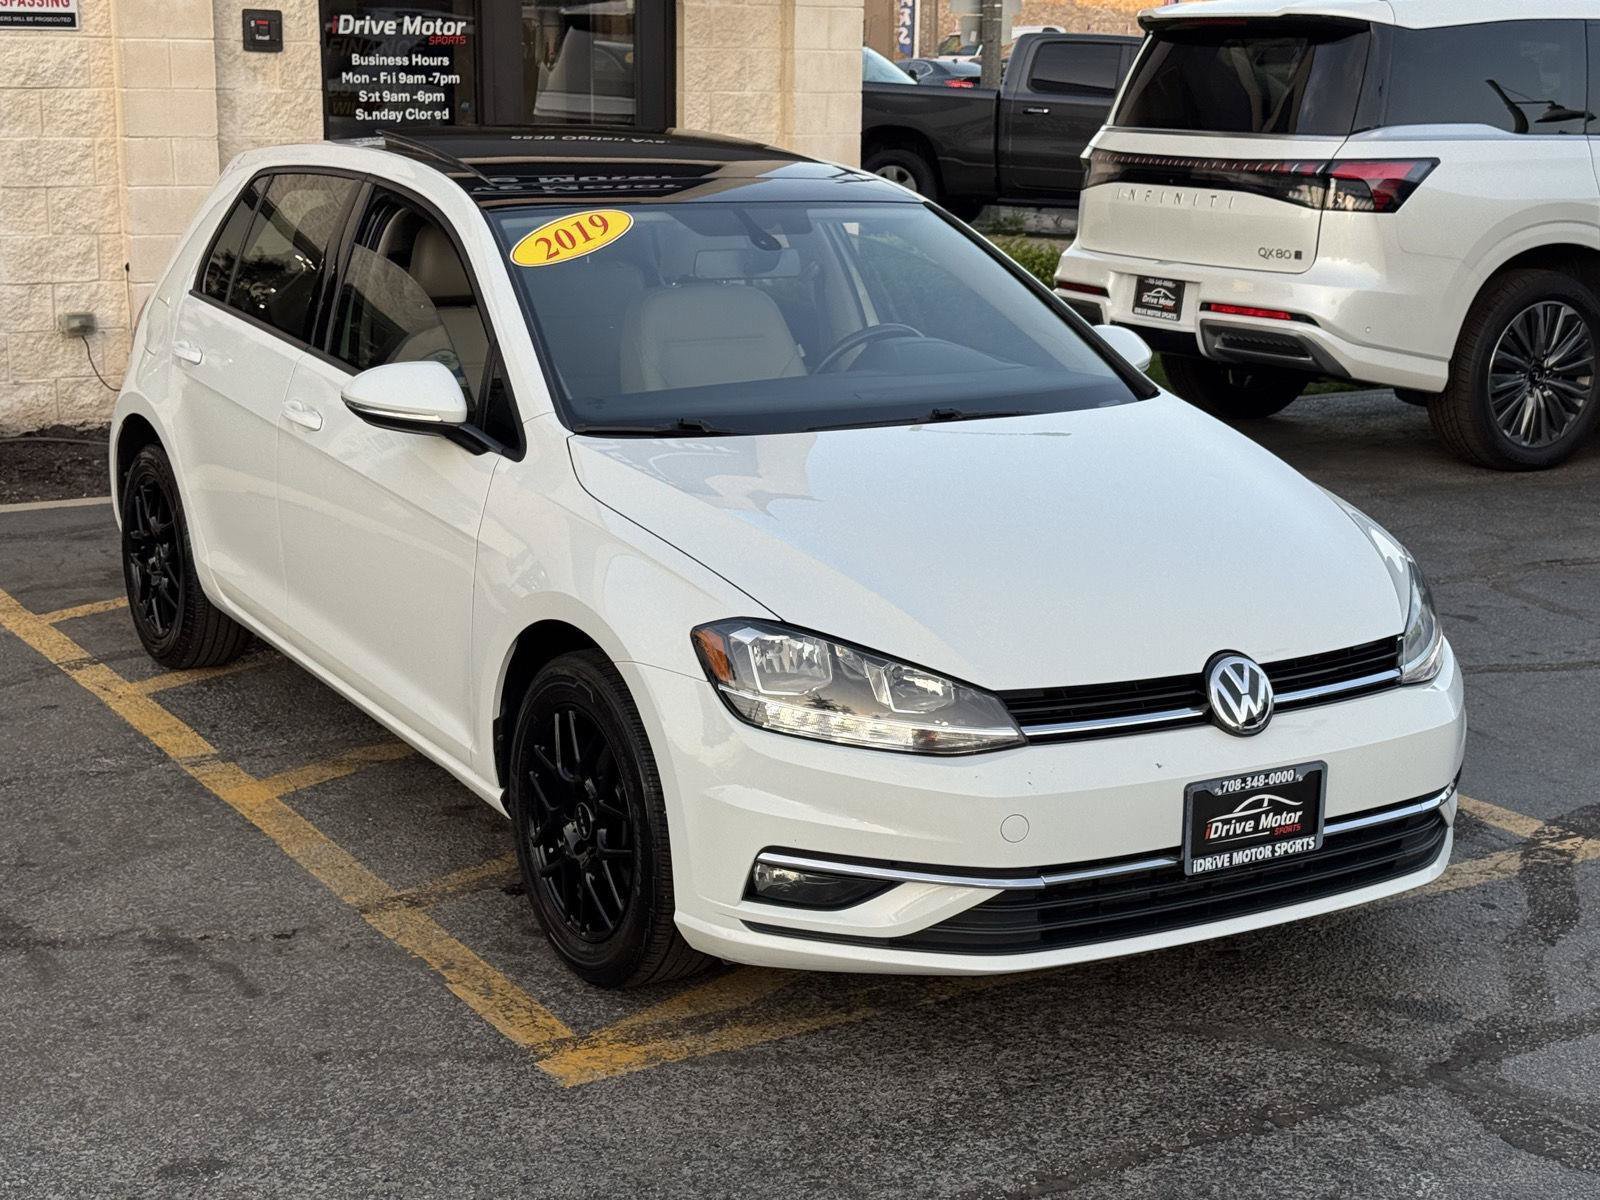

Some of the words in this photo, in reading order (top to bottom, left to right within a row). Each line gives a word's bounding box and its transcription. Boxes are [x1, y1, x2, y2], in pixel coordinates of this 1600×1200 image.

[332, 14, 397, 35] iDrive
[402, 15, 467, 36] Motor
[428, 35, 467, 46] SPORTS
[351, 53, 409, 66] Business
[412, 53, 450, 66] Hours
[341, 72, 369, 84] Mon
[398, 72, 426, 84] 9am
[383, 90, 410, 102] 9am
[1116, 188, 1234, 209] INFINITI
[535, 214, 609, 260] 2019
[1258, 247, 1292, 260] QX80
[1222, 769, 1294, 794] 708-348-0000
[1205, 819, 1255, 840] iDrive
[1259, 810, 1304, 831] Motor
[1273, 823, 1302, 836] SPORTS
[1232, 845, 1272, 866] MOTOR
[1274, 835, 1316, 856] SPORTS
